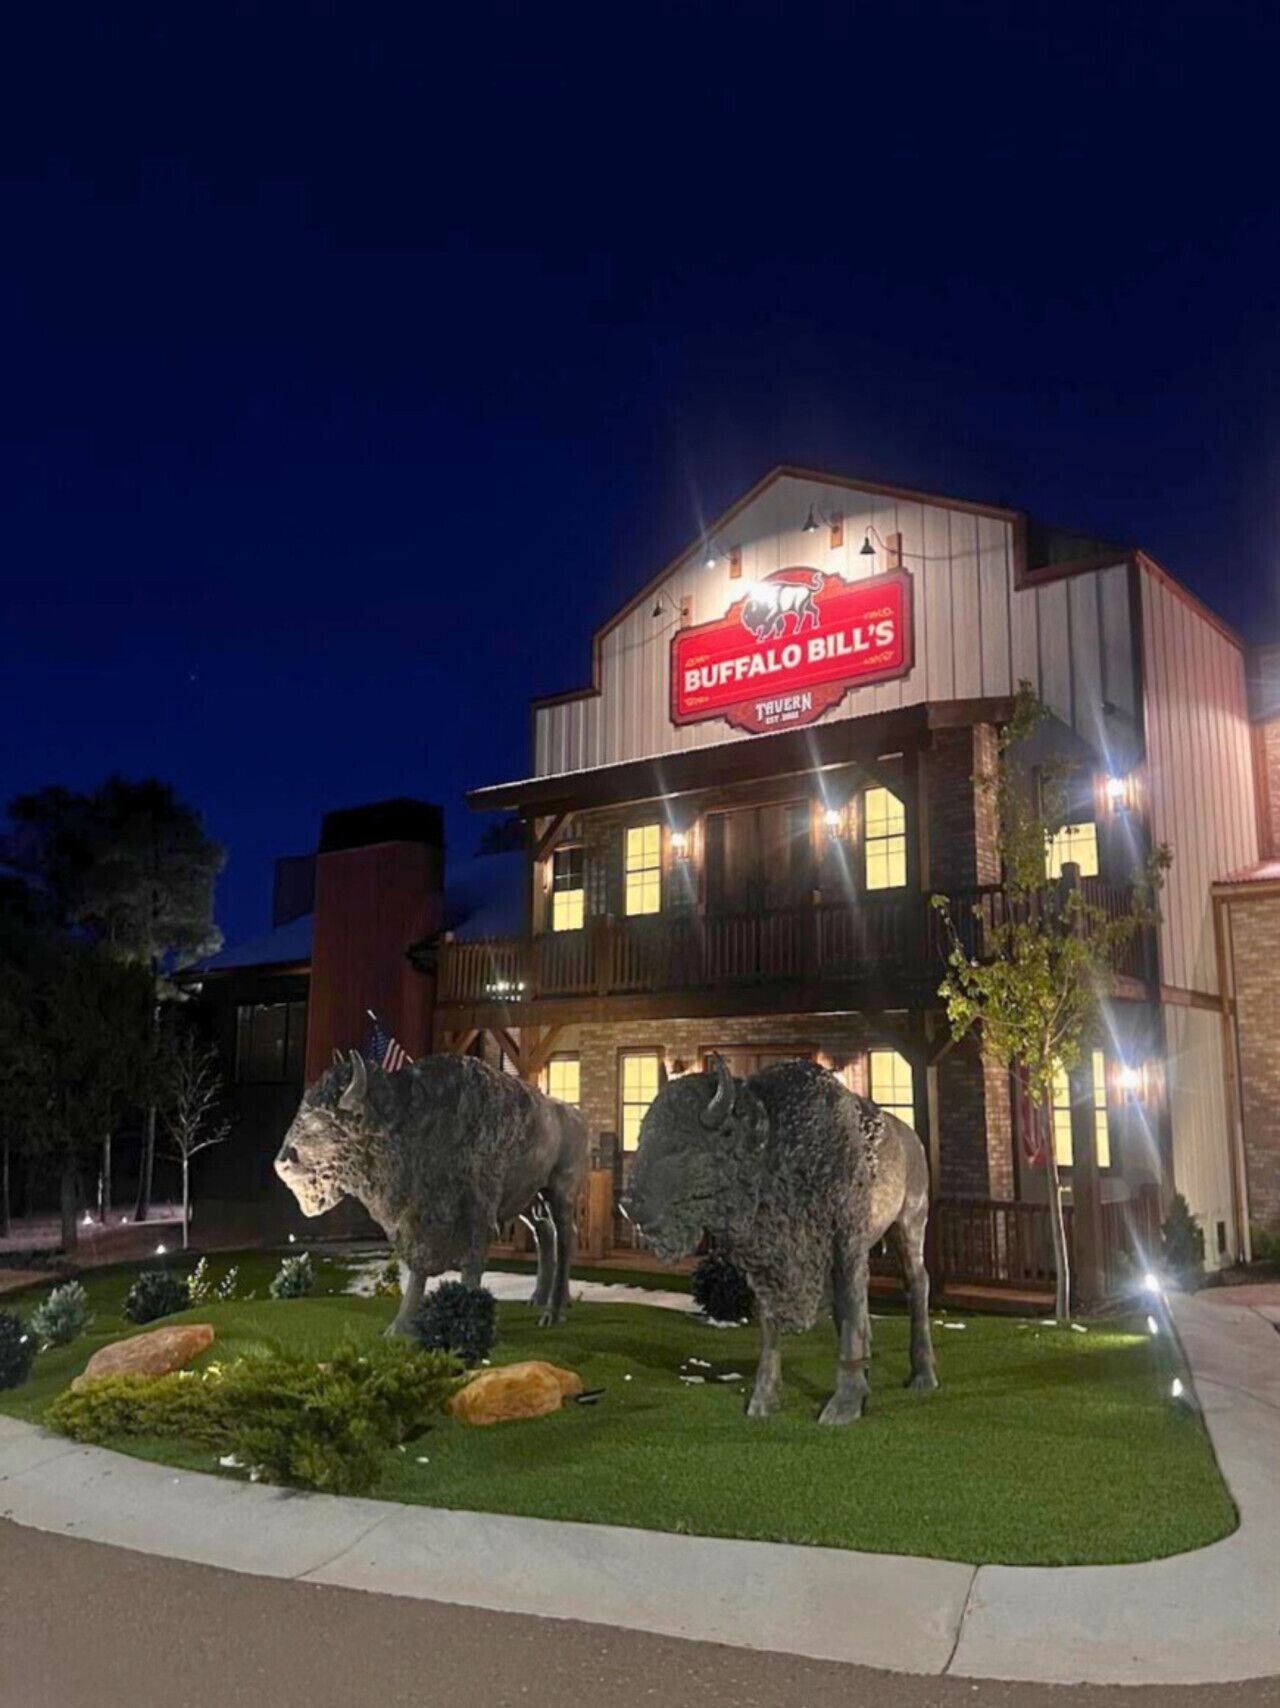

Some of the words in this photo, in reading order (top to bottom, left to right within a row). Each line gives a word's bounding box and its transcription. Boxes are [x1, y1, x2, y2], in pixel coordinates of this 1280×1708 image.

[684, 644, 801, 692] BUFFALO
[807, 620, 894, 663] BILL'S
[755, 692, 812, 721] TAVERN
